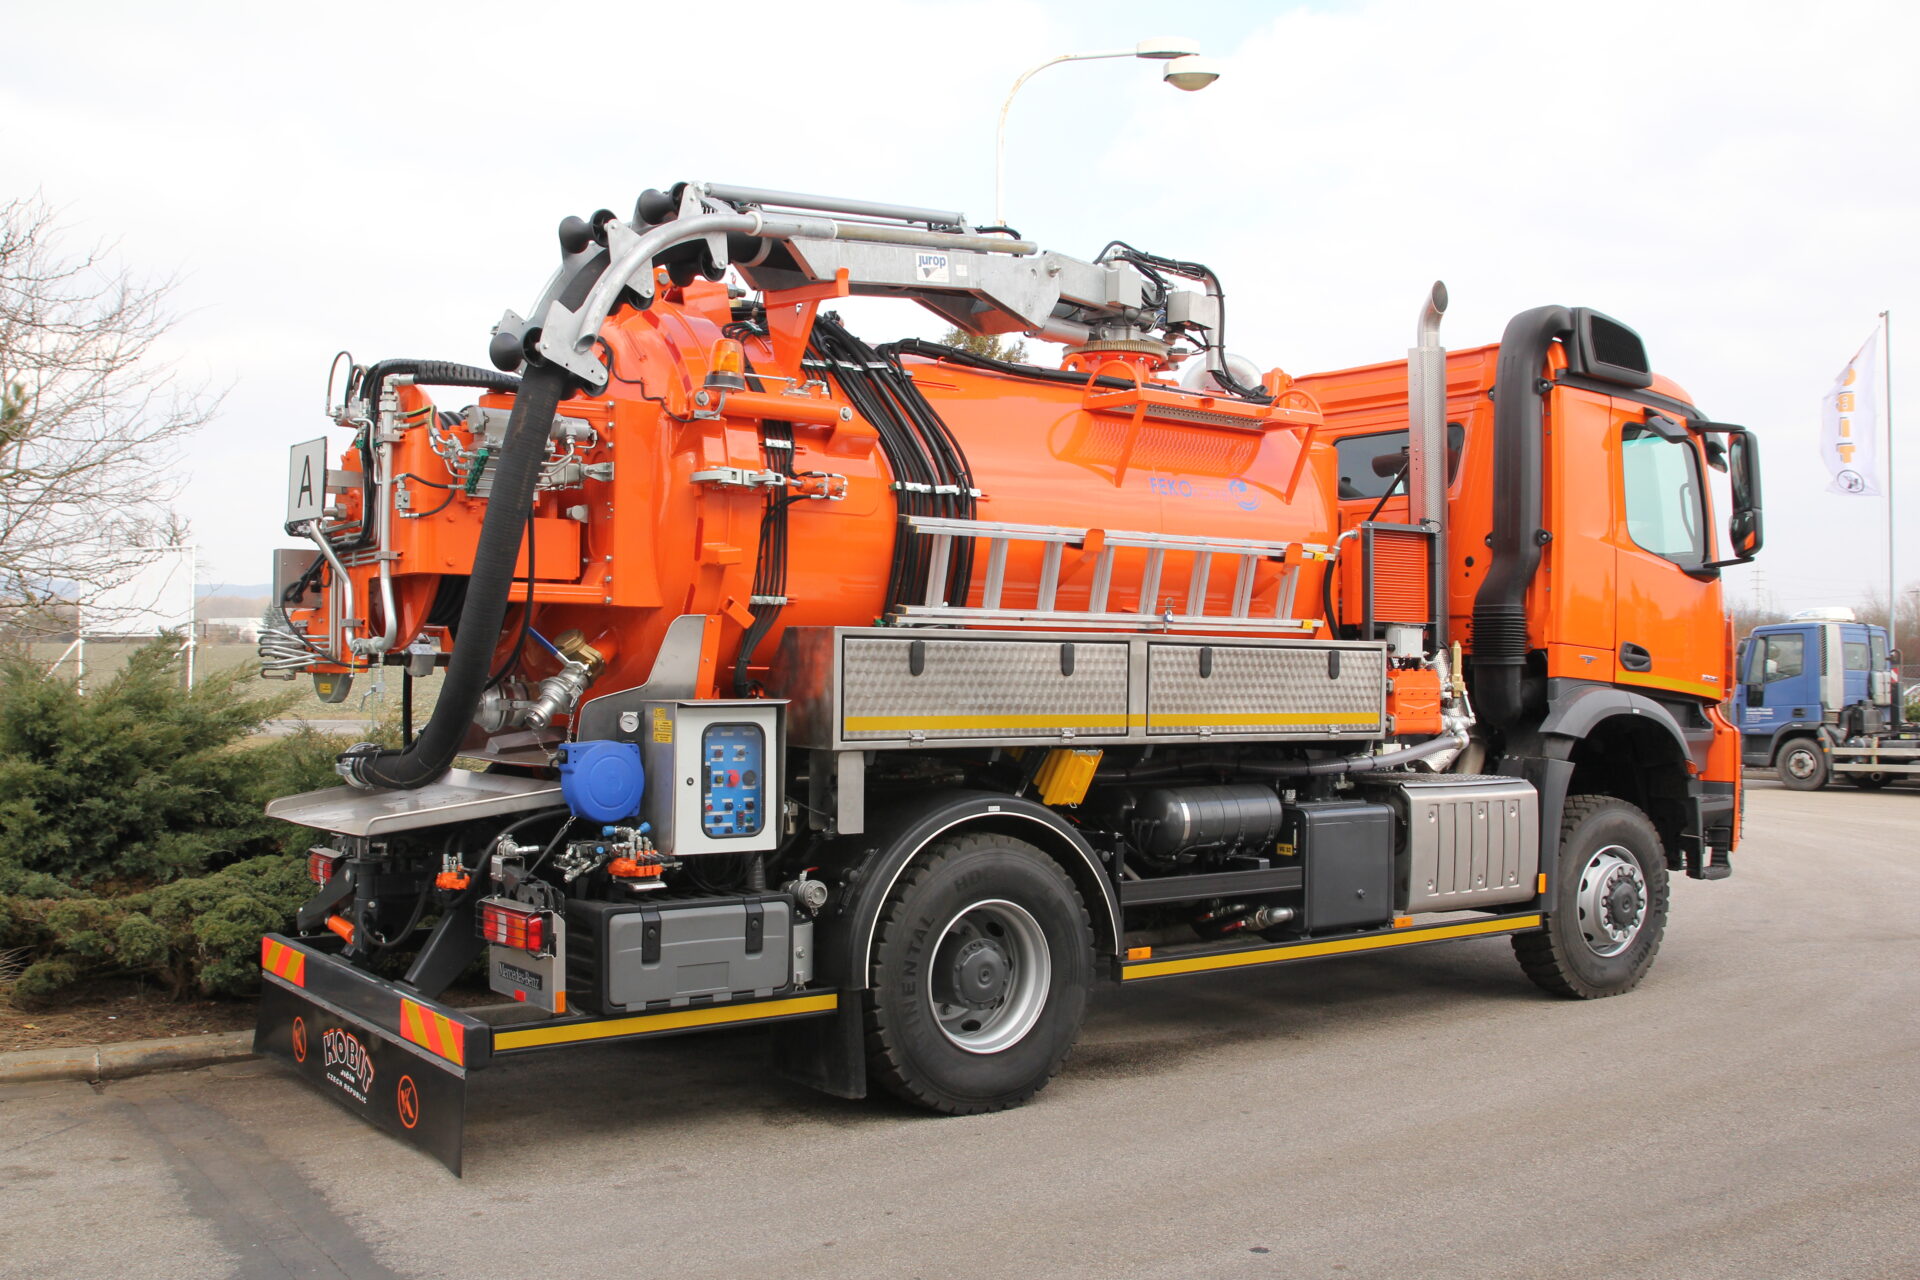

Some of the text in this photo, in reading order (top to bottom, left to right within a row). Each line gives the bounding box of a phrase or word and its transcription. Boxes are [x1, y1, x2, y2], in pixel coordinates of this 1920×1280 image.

[918, 255, 946, 269] jurop
[298, 455, 313, 508] A
[499, 962, 540, 989] Mercedes-Benz
[322, 1028, 375, 1093] KOBIT
[326, 1072, 367, 1104] CZECH REPUBLIC
